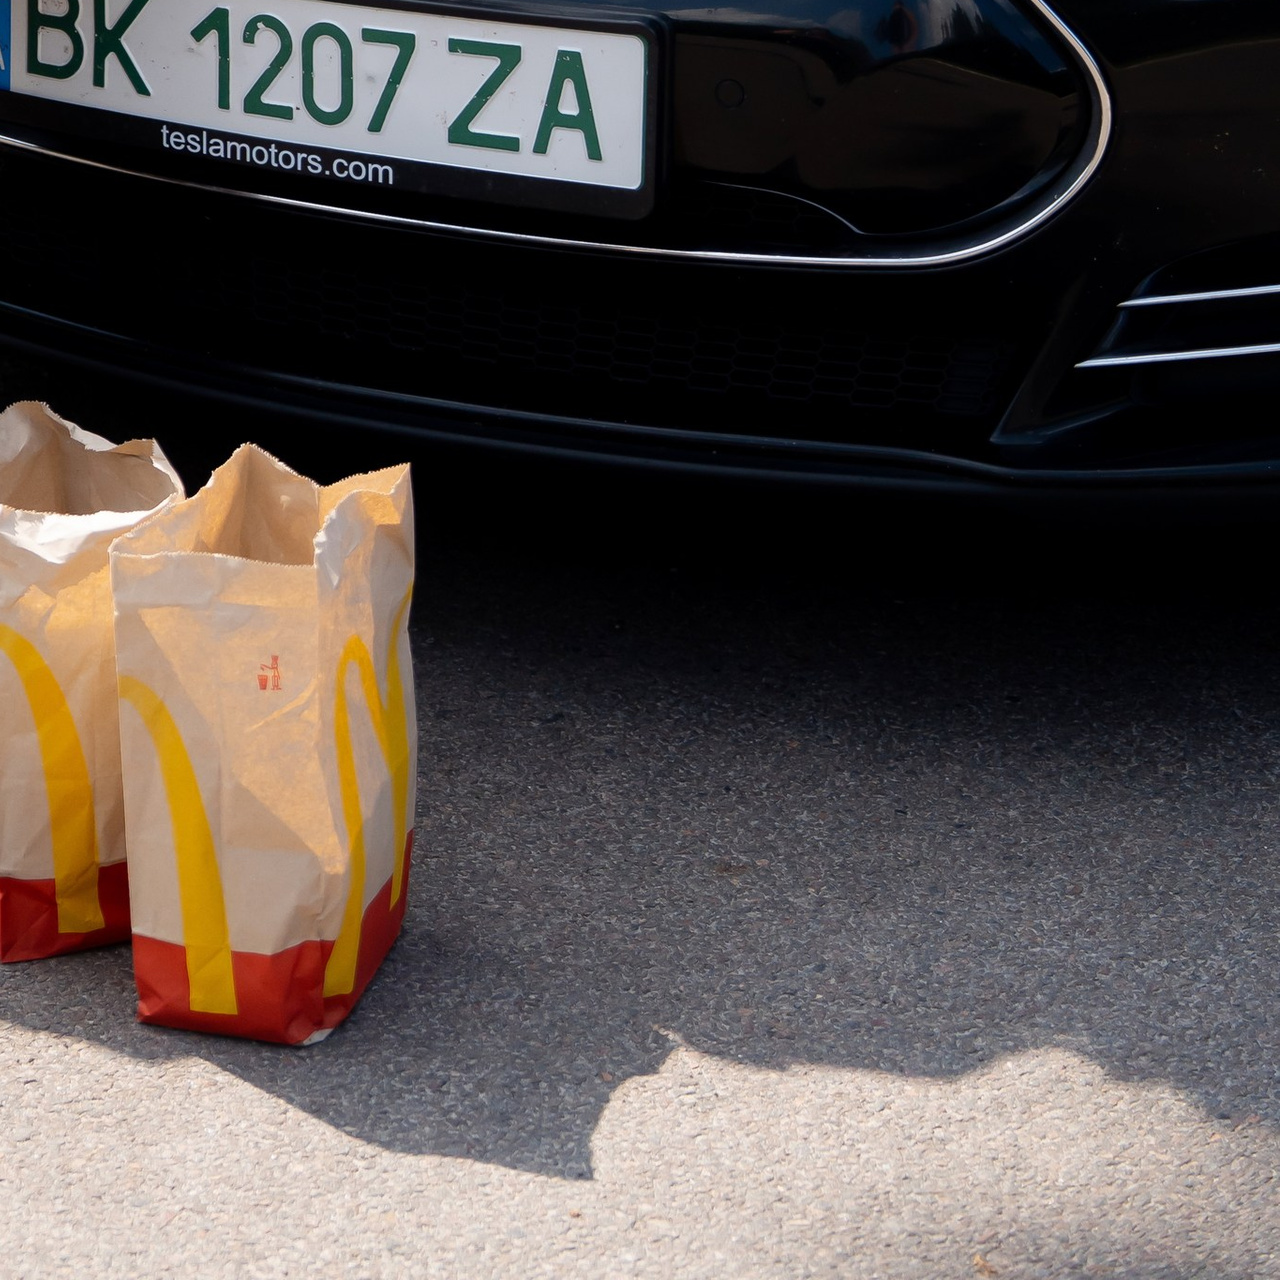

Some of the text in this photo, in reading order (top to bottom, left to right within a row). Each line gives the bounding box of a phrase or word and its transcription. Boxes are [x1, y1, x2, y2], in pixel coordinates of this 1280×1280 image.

[189, 6, 417, 133] 1207
[447, 37, 602, 162] ZA
[160, 122, 395, 185] teslamotors.com
